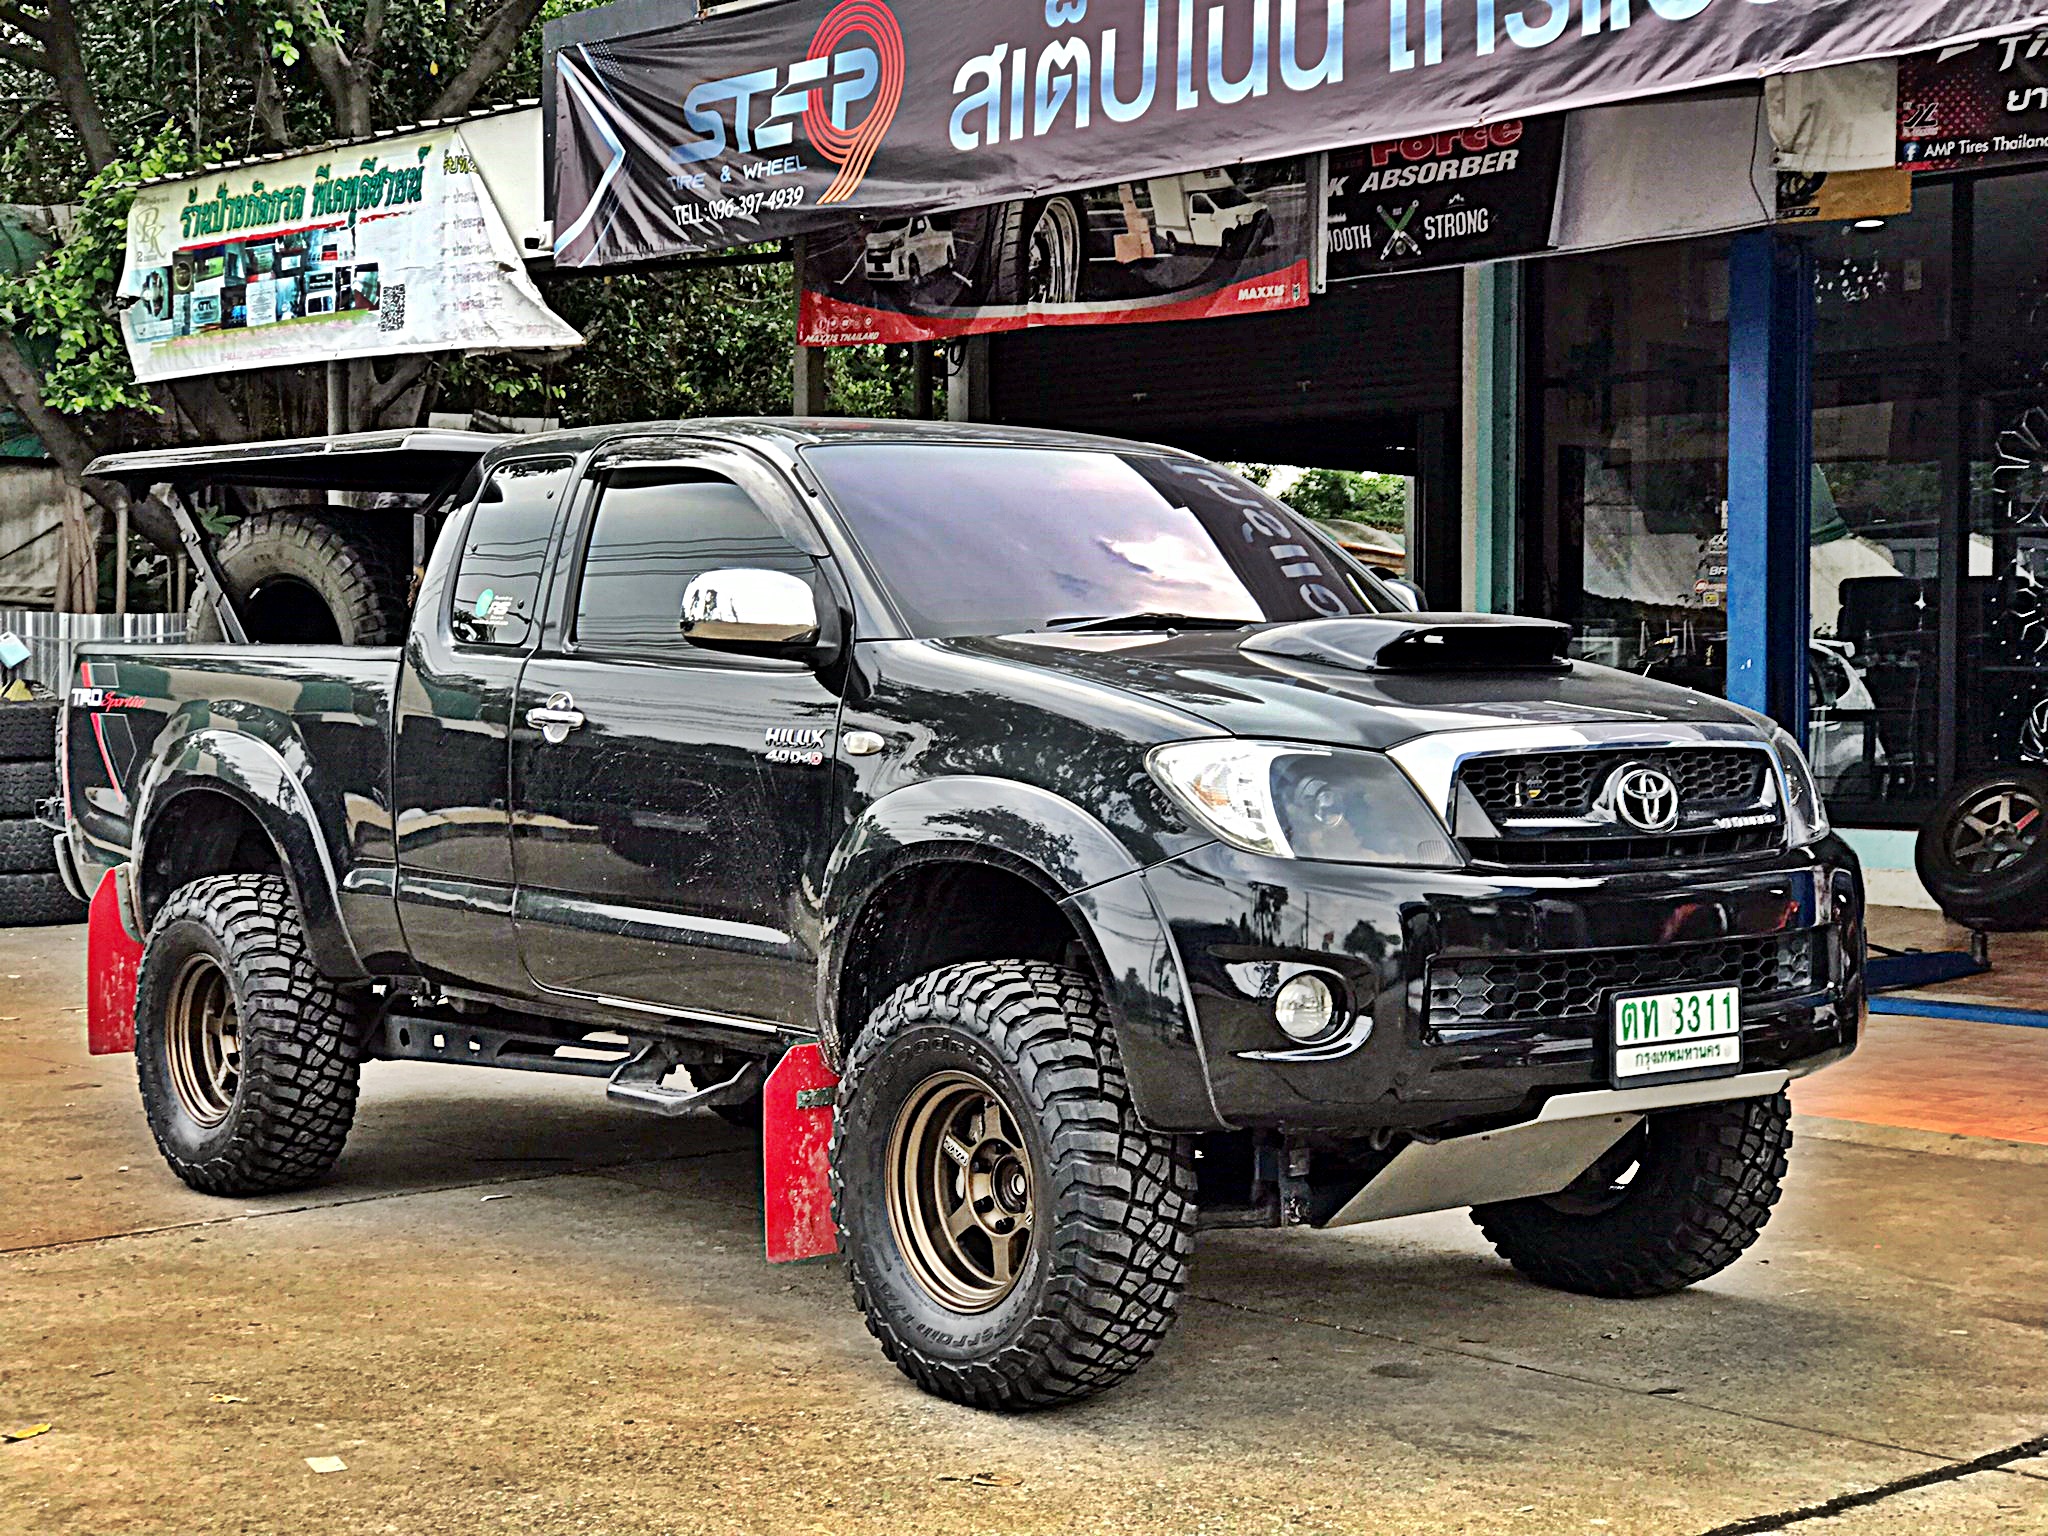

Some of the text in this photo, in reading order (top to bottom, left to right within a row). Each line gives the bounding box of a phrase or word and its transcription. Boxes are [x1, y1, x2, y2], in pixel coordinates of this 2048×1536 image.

[671, 47, 879, 165] STEP
[1924, 141, 1956, 158] AMP
[1958, 139, 1989, 154] Tires
[666, 155, 808, 191] TIRE & WHEEL
[1359, 149, 1519, 194] ABSORBER
[1423, 208, 1489, 240] STRONG
[1237, 284, 1285, 301] MAXXIS
[803, 331, 880, 344] MAXXIS THAILAND
[765, 727, 827, 748] HILUX
[1635, 1044, 1721, 1071] กรุงเทพมหานคร
